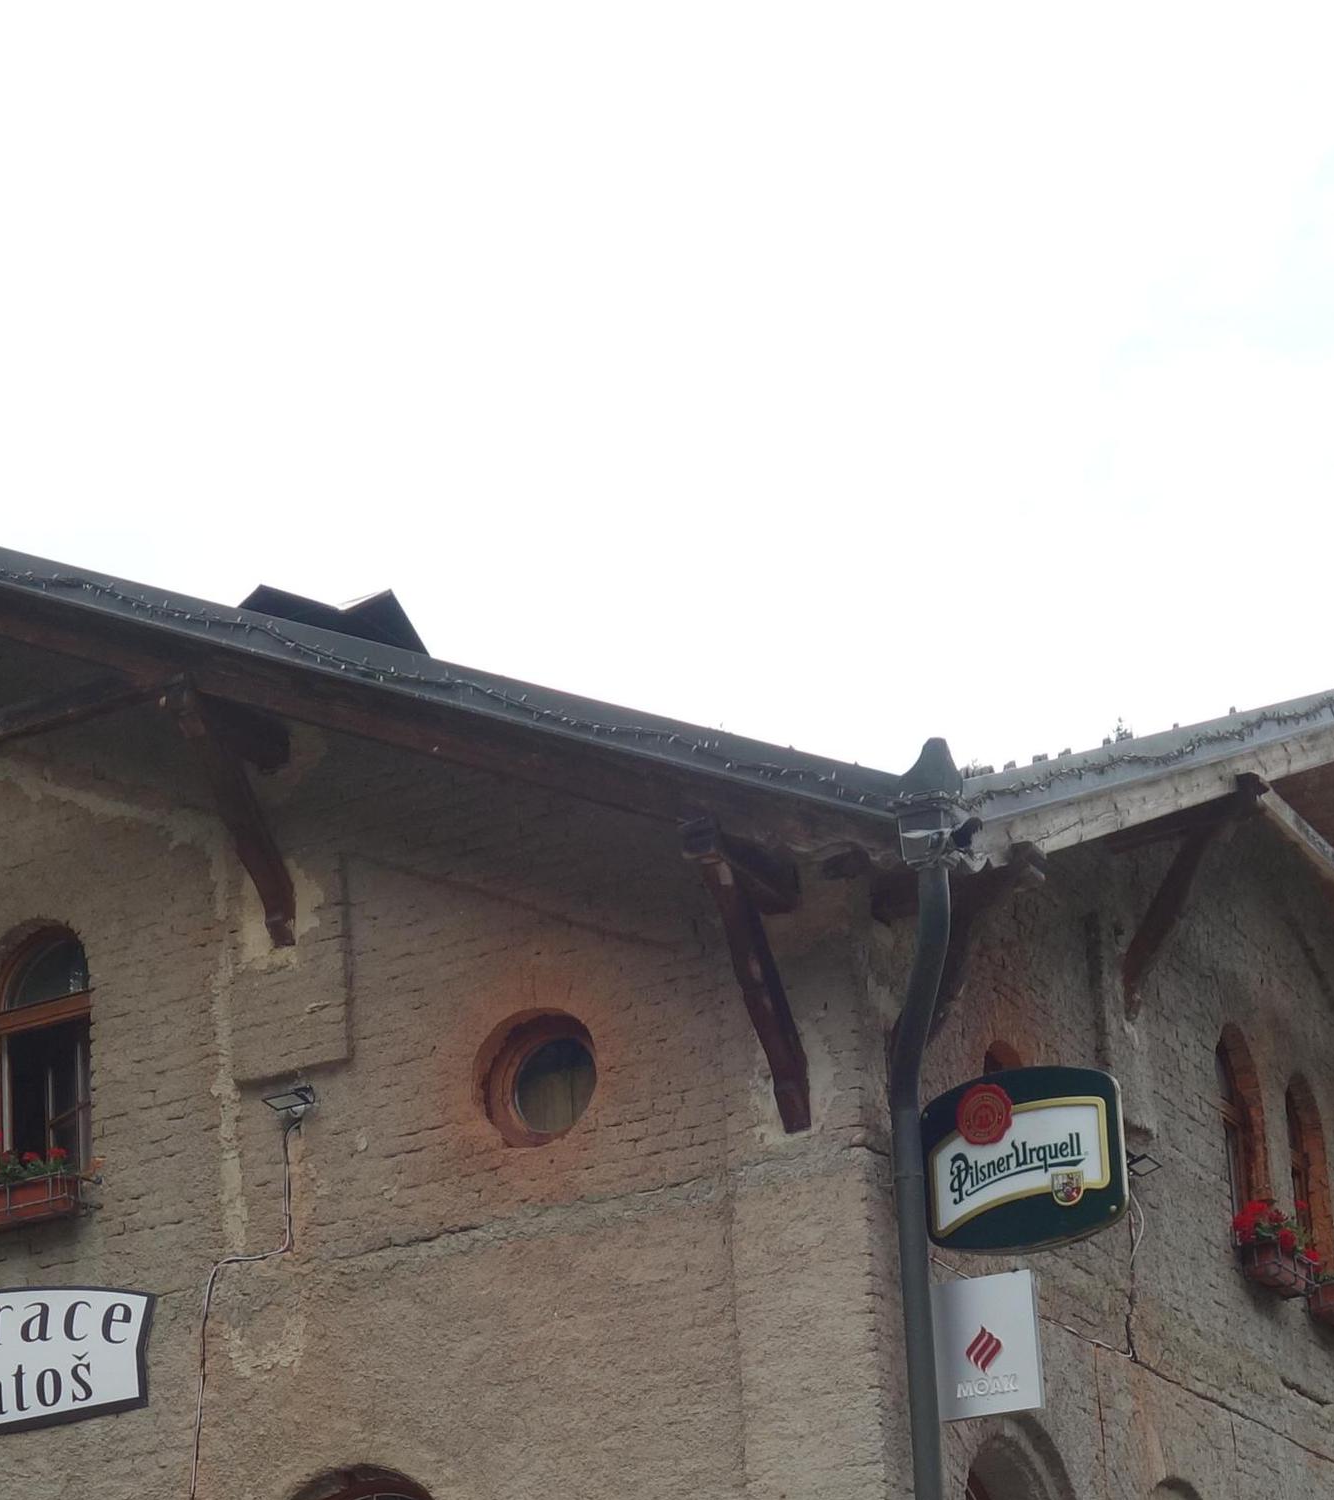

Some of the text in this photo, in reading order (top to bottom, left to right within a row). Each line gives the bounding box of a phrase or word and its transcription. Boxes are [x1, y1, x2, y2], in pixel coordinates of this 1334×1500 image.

[950, 1132, 1082, 1205] Pilsner Urquell
[956, 1373, 1019, 1400] MOAK
